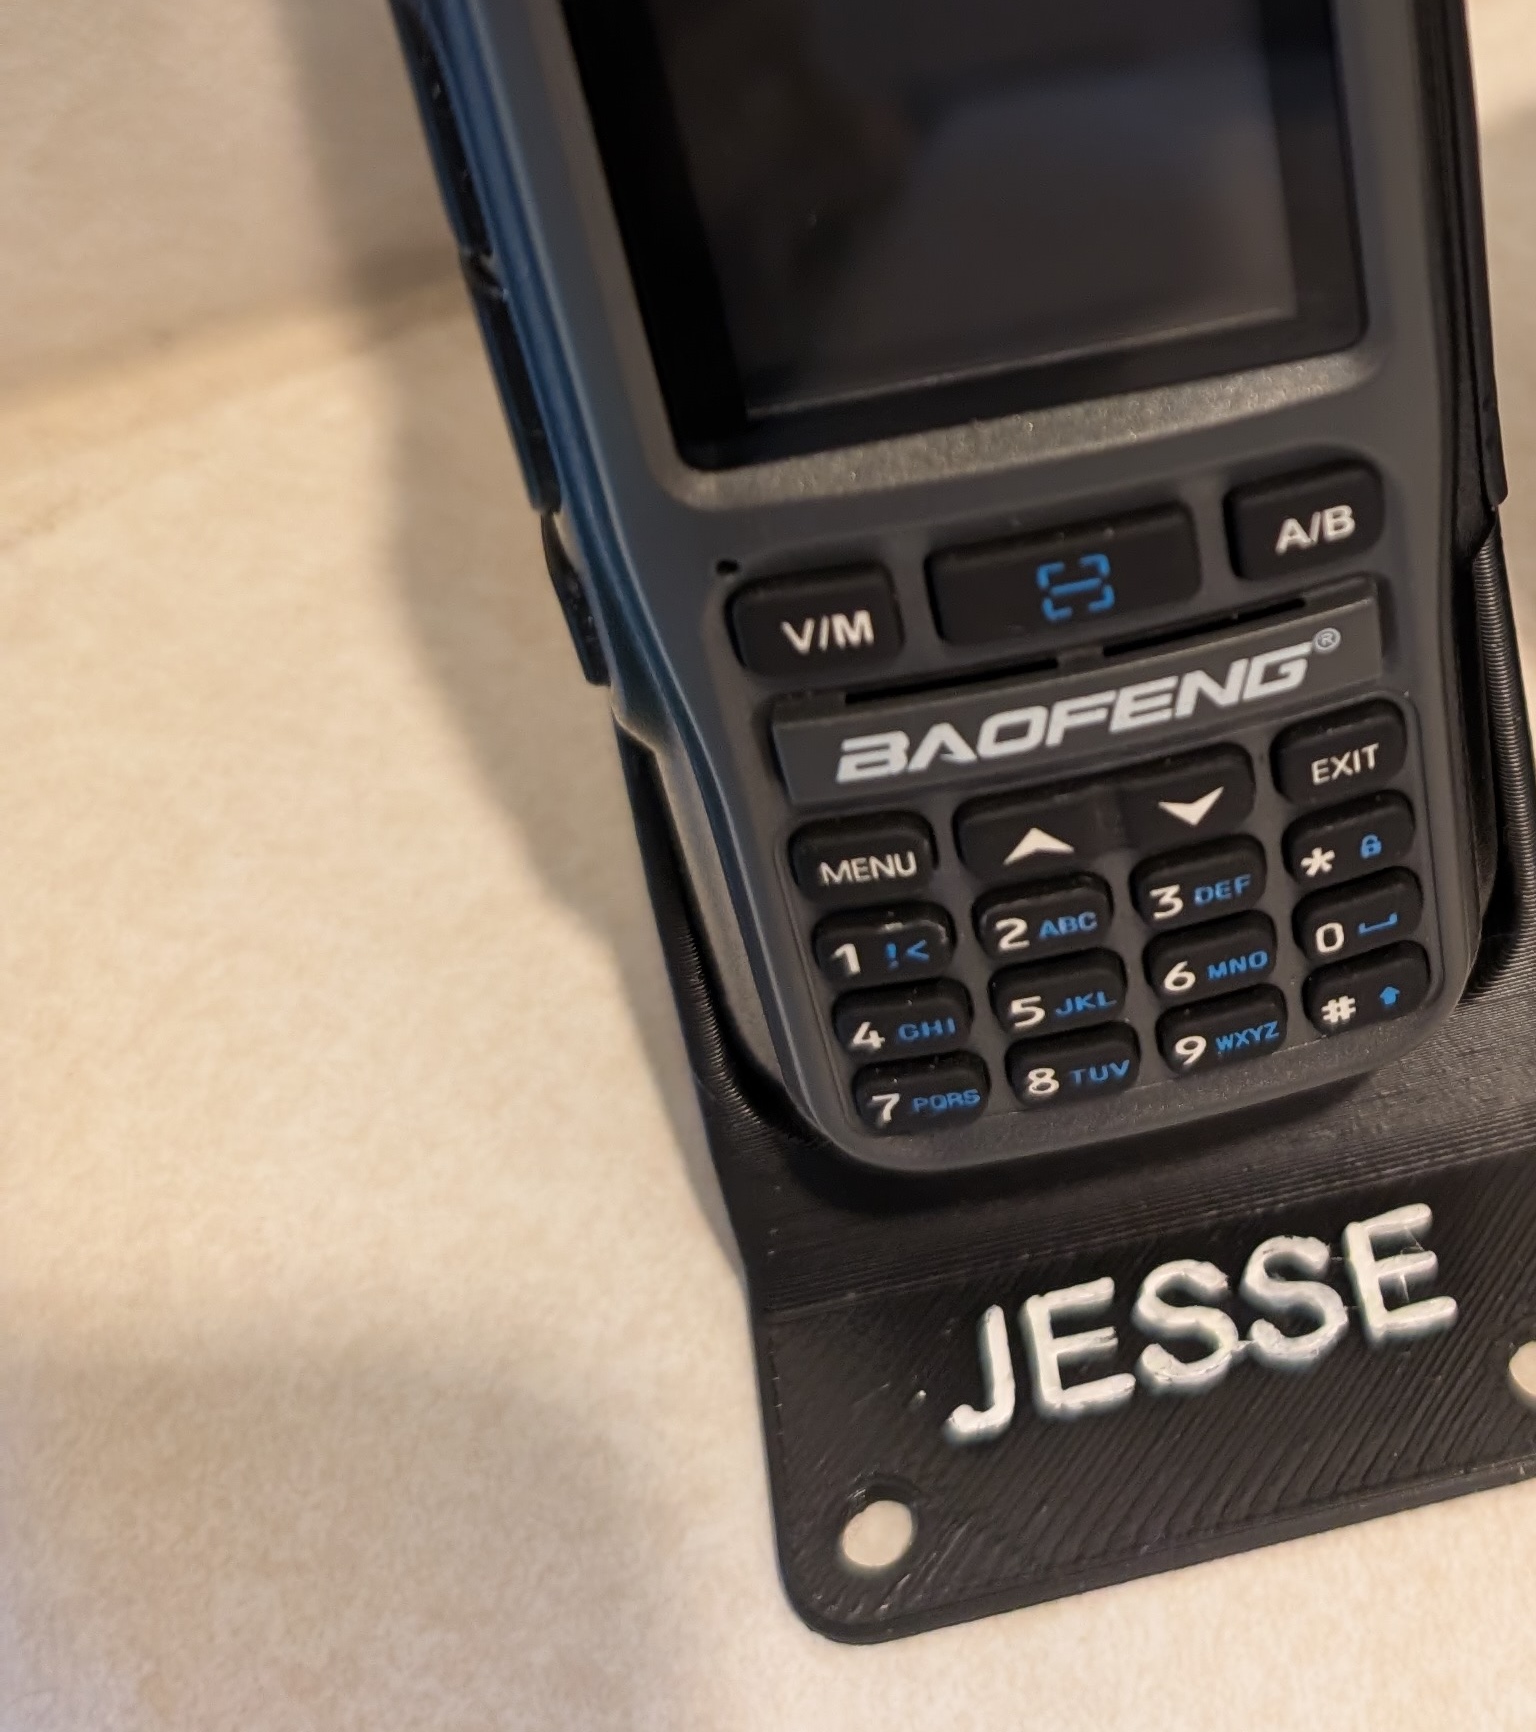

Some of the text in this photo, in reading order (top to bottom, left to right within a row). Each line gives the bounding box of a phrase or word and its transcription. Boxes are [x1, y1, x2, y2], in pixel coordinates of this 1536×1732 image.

[1275, 504, 1356, 554] A/B
[782, 608, 875, 654] V/M
[1310, 743, 1380, 786] EXIT
[819, 850, 918, 886] MENU
[1149, 874, 1253, 920] 3 DEF
[994, 909, 1098, 951] 2 ABC
[1314, 922, 1345, 953] 0
[831, 944, 862, 974] 1
[1163, 949, 1269, 991] 6 MNO
[1009, 988, 1117, 1027] 5 JKL
[850, 1015, 956, 1051] 4 GHI
[1173, 1020, 1280, 1065] 9 WXYZ
[1026, 1058, 1131, 1095] 8 TUV
[871, 1086, 982, 1124] 7 PQRS
[944, 1202, 1458, 1442] JESSE
